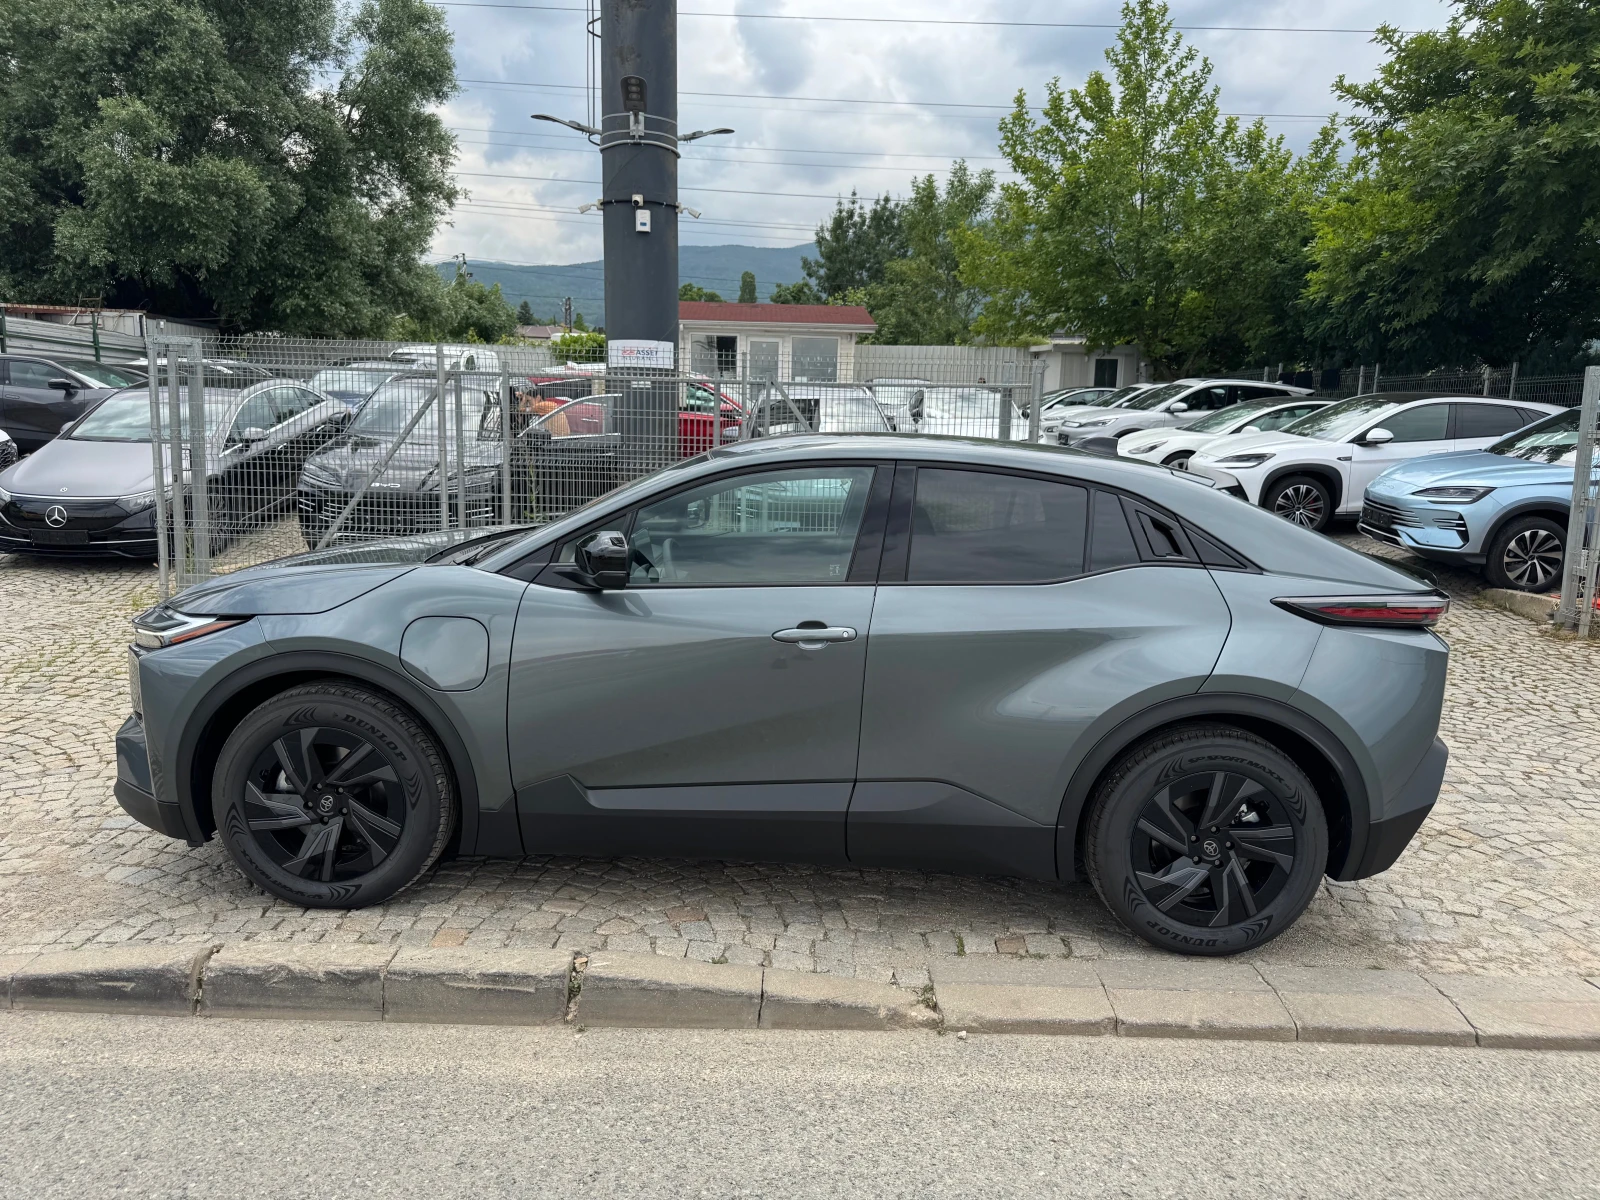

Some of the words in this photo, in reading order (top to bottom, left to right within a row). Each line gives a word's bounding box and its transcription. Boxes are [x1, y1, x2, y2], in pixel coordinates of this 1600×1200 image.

[342, 714, 408, 761] DUNLOP
[1206, 755, 1248, 764] SPORT
[1246, 760, 1285, 783] MAXX
[240, 848, 272, 880] MAXX
[1145, 920, 1219, 947] DUNLOP
